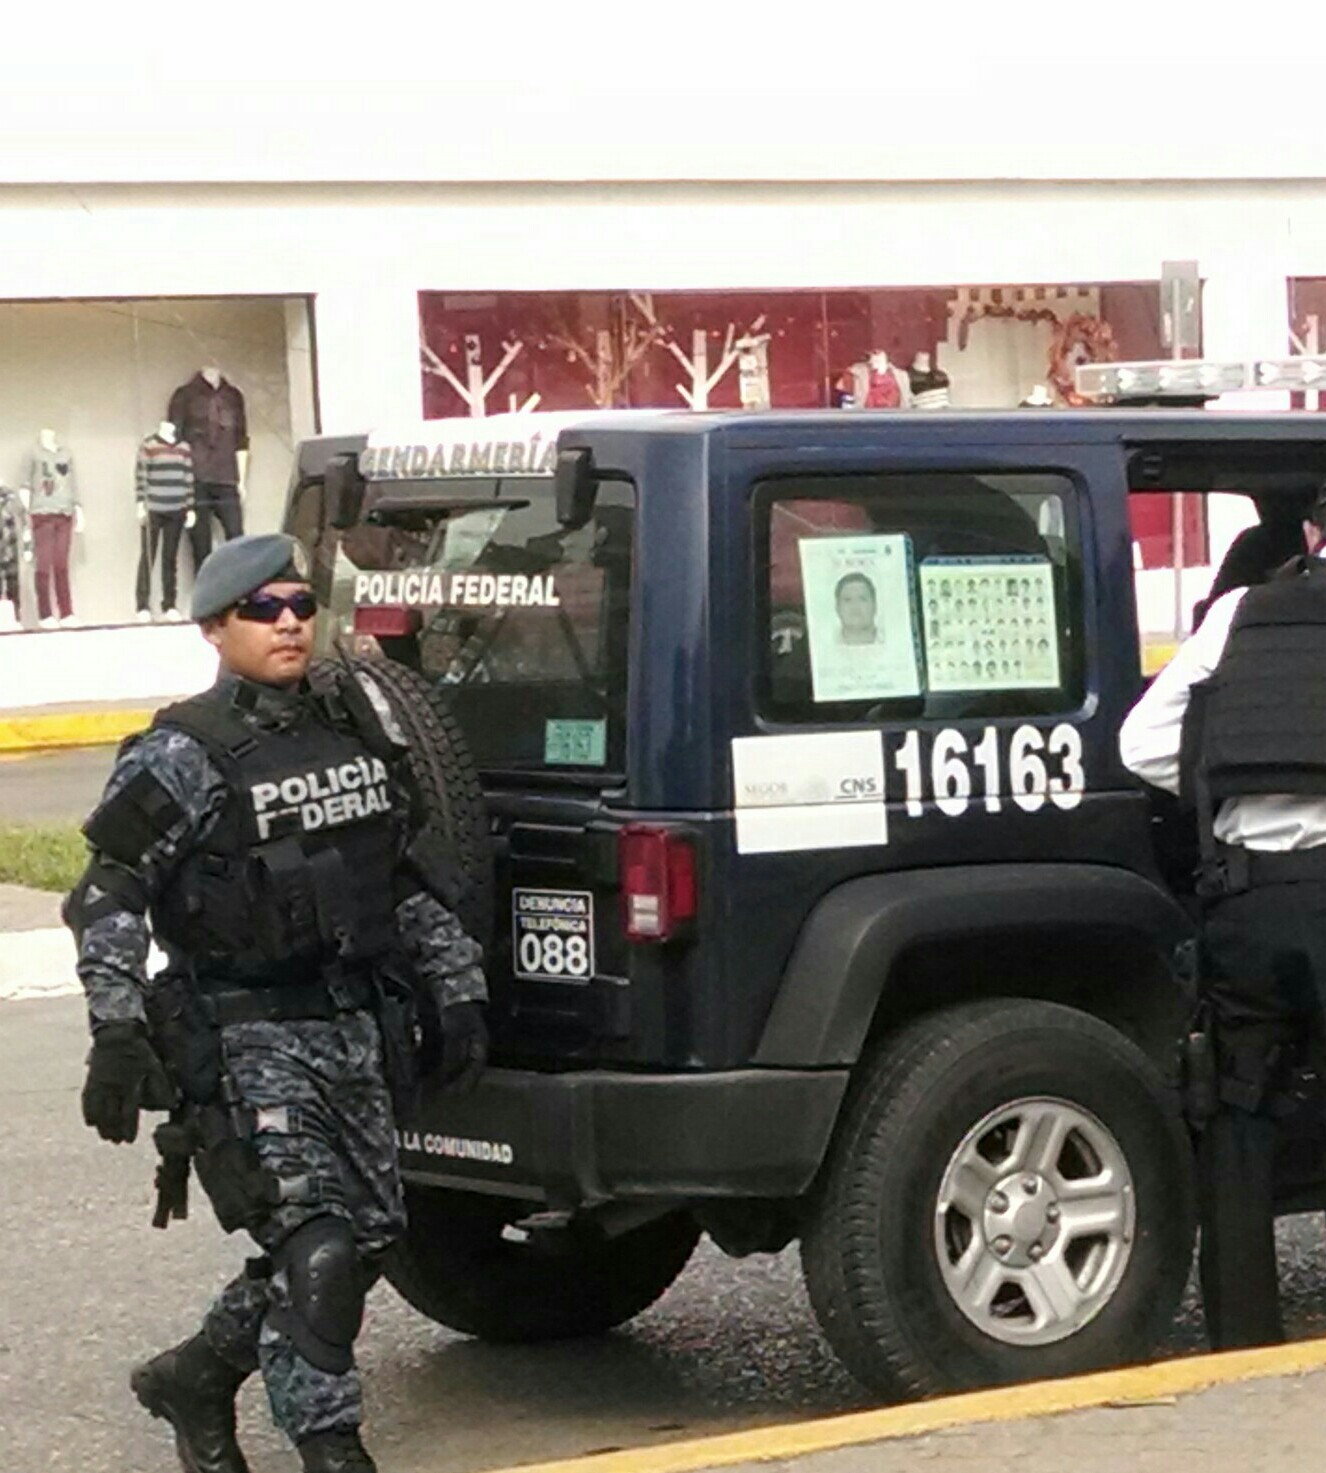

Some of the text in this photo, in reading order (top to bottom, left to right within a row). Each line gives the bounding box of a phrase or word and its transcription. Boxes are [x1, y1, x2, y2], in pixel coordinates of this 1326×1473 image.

[354, 567, 560, 607] POLICÍA FEDERAL
[251, 756, 388, 812] POLICÍA
[840, 777, 877, 793] CNS
[895, 723, 1086, 817] 16163
[256, 785, 392, 840] FDERAL
[519, 895, 587, 914] DENUNCIA
[520, 933, 588, 976] 088
[403, 1131, 421, 1151] LA
[424, 1133, 512, 1164] COMUNIDAD
